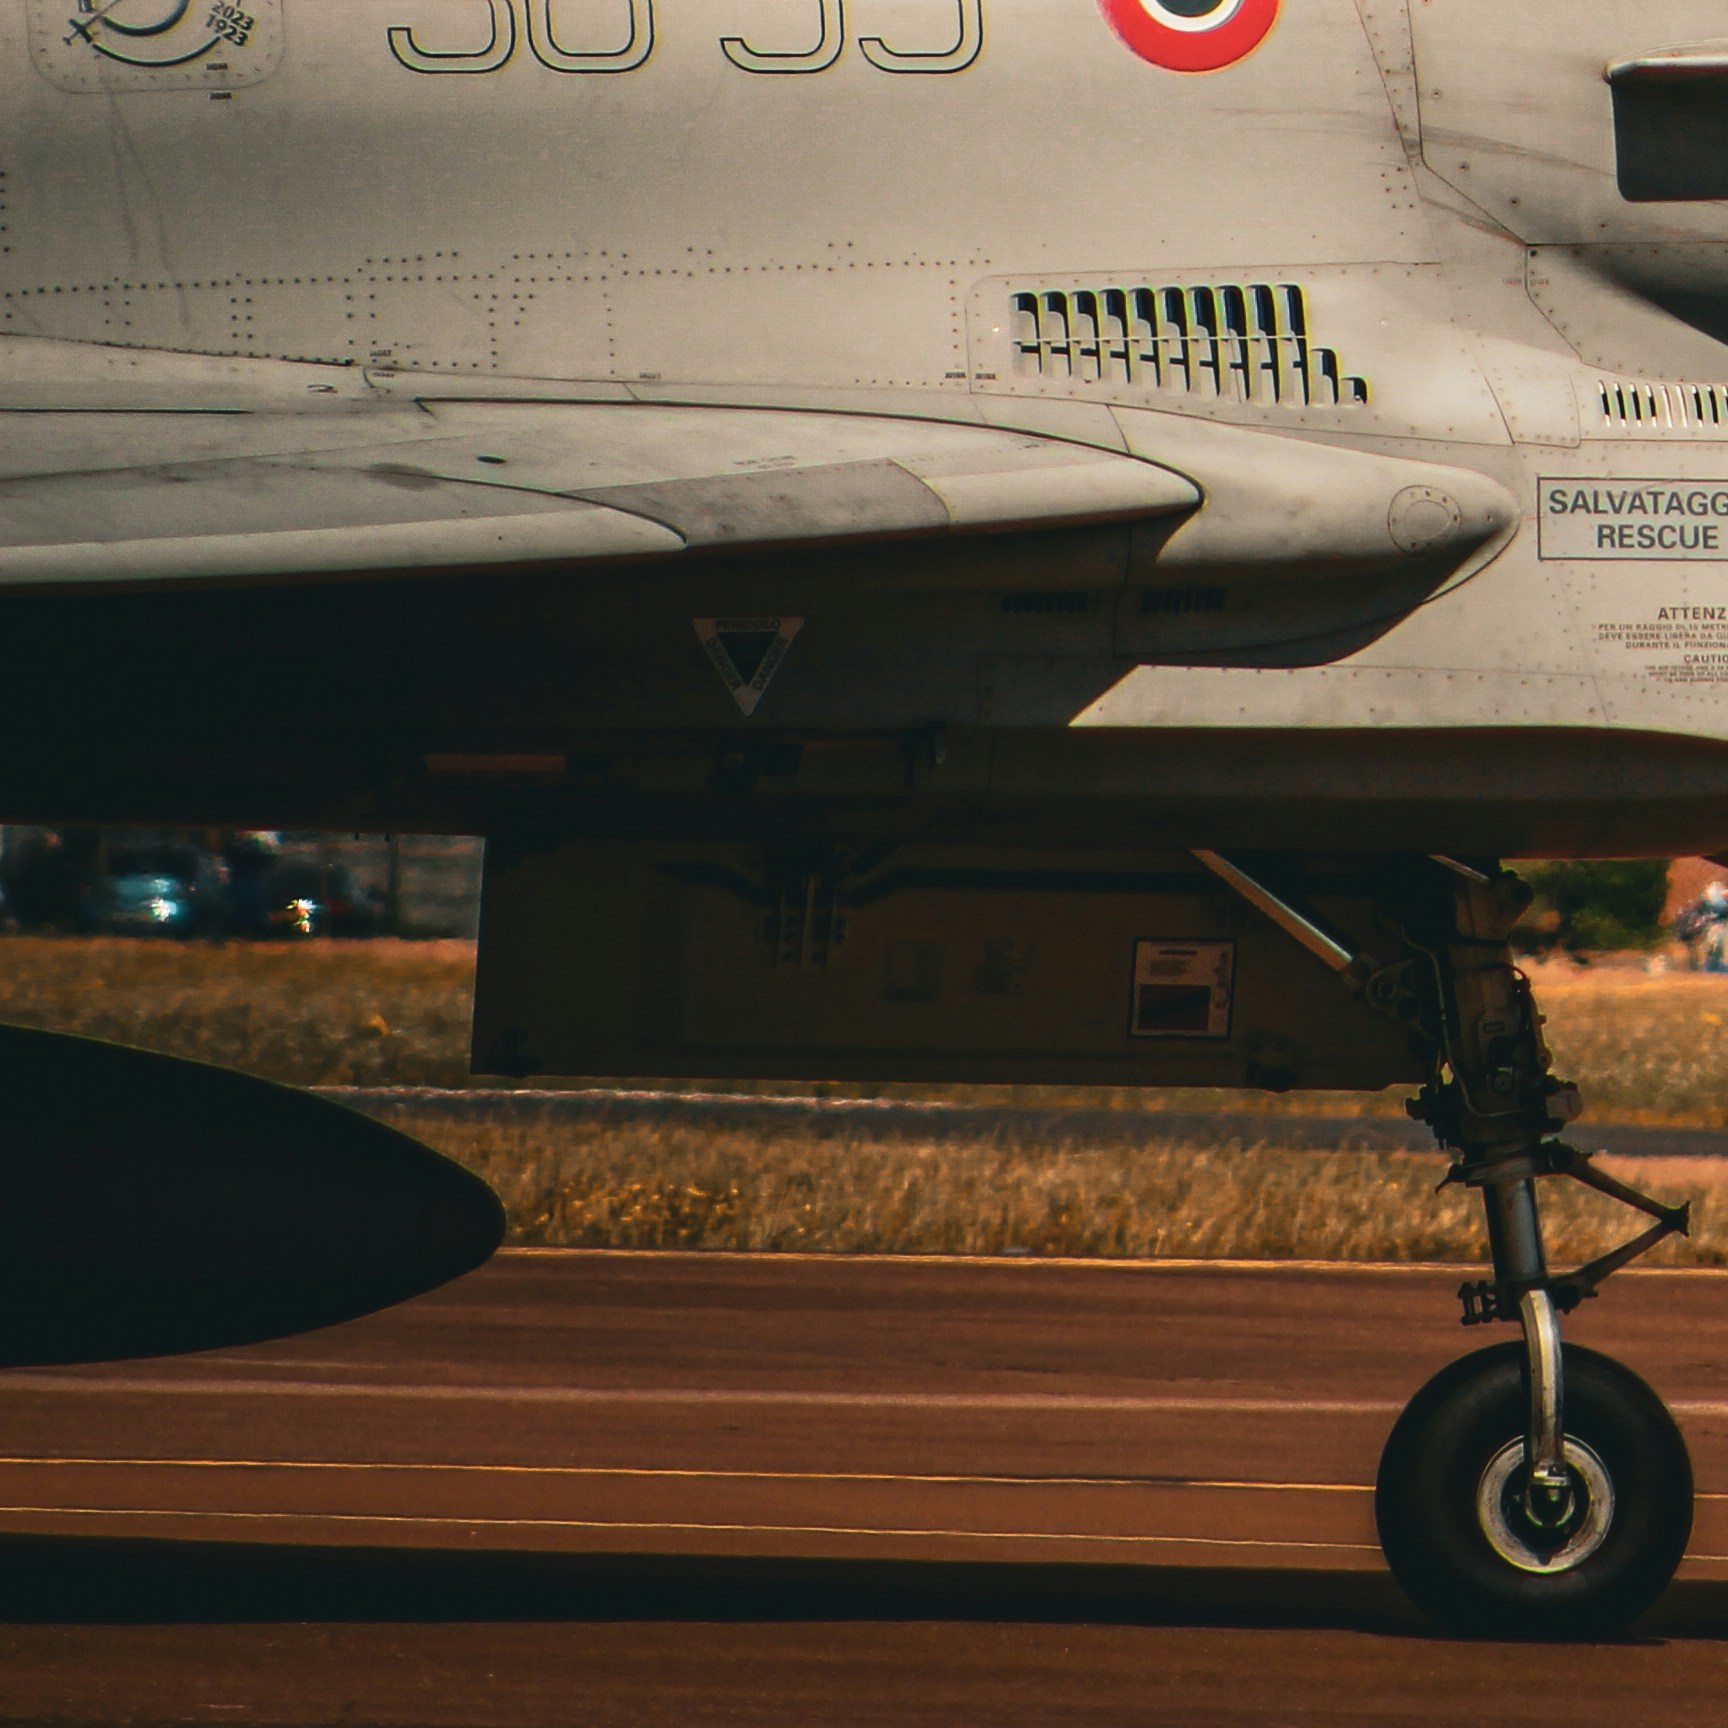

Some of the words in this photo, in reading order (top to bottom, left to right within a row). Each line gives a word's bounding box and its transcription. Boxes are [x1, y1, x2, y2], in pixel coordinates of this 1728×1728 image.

[211, 0, 255, 31] 2023
[206, 13, 249, 47] 1923
[1597, 524, 1720, 550] RESCUE
[1598, 623, 1616, 631] PER
